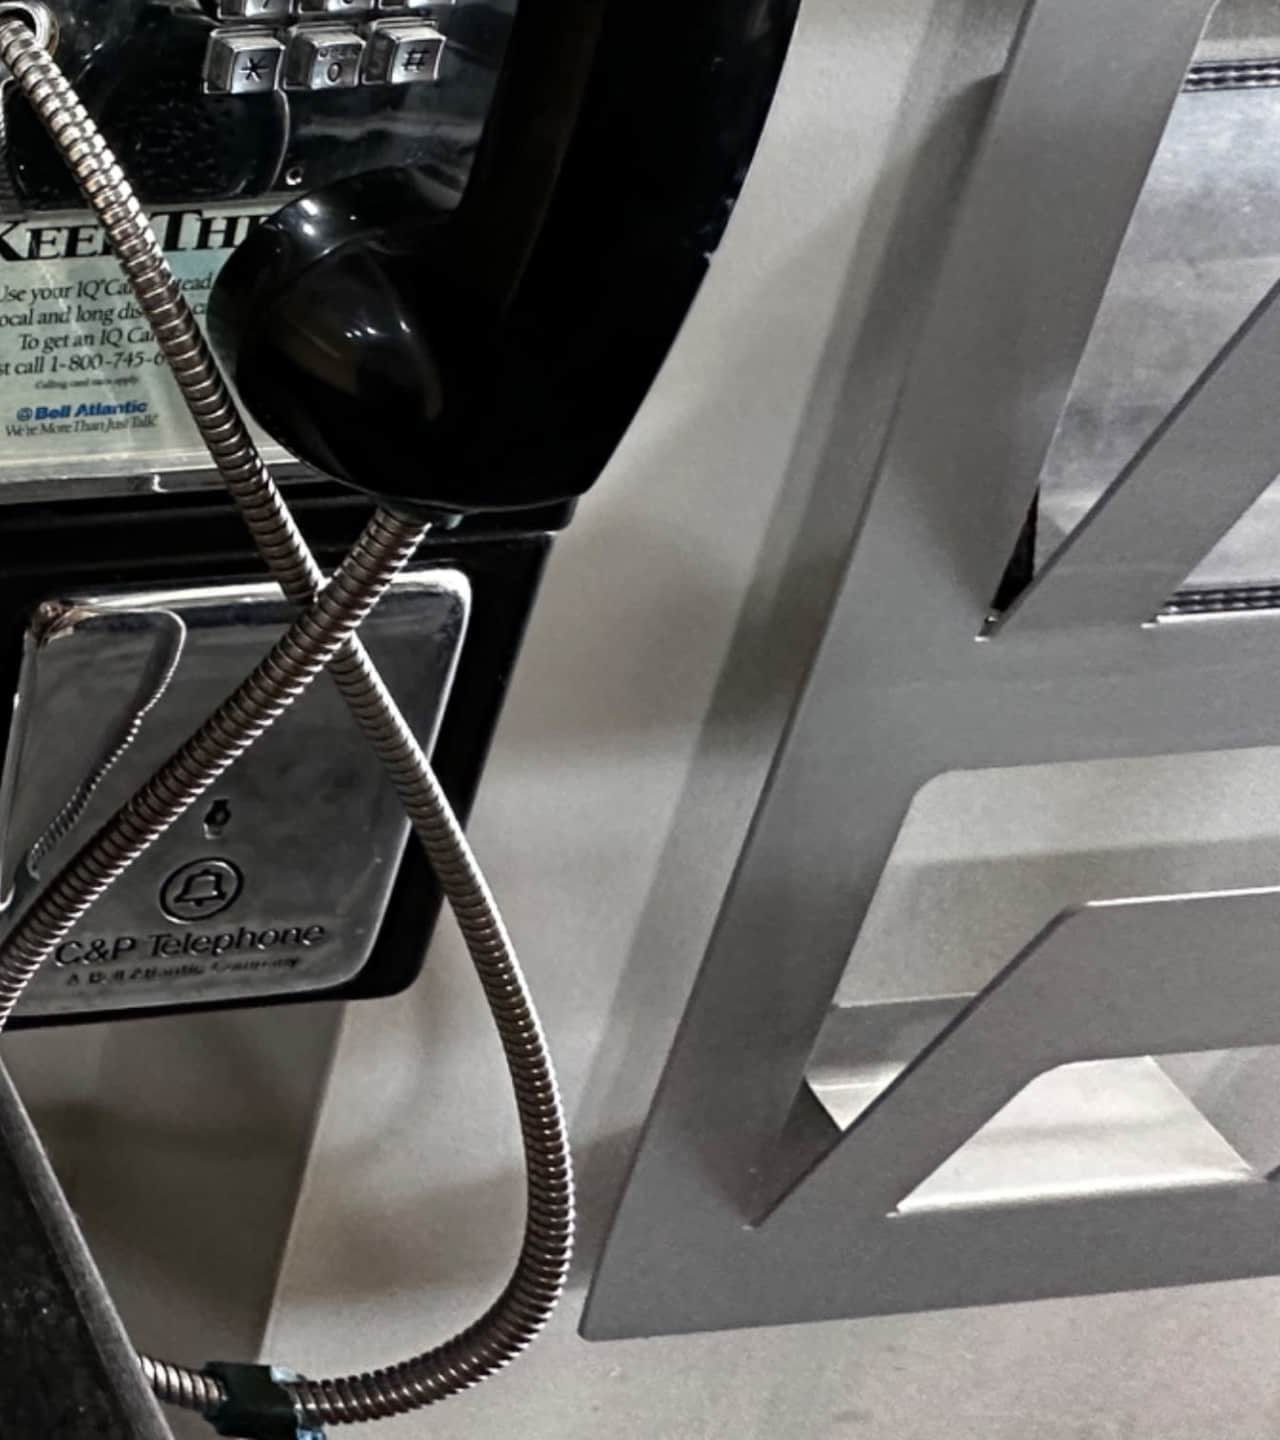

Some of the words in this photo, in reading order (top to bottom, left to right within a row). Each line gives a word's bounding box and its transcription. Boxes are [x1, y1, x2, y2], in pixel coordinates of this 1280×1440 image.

[30, 285, 72, 305] your
[38, 306, 71, 325] and
[76, 305, 114, 326] long
[19, 333, 40, 351] To
[43, 335, 70, 353] get
[73, 333, 94, 348] an
[101, 328, 122, 348] IQ
[14, 356, 44, 375] call
[34, 405, 71, 421] Bell
[75, 401, 148, 418] Atlantic
[54, 936, 137, 967] C&P
[147, 925, 325, 959] Telephone
